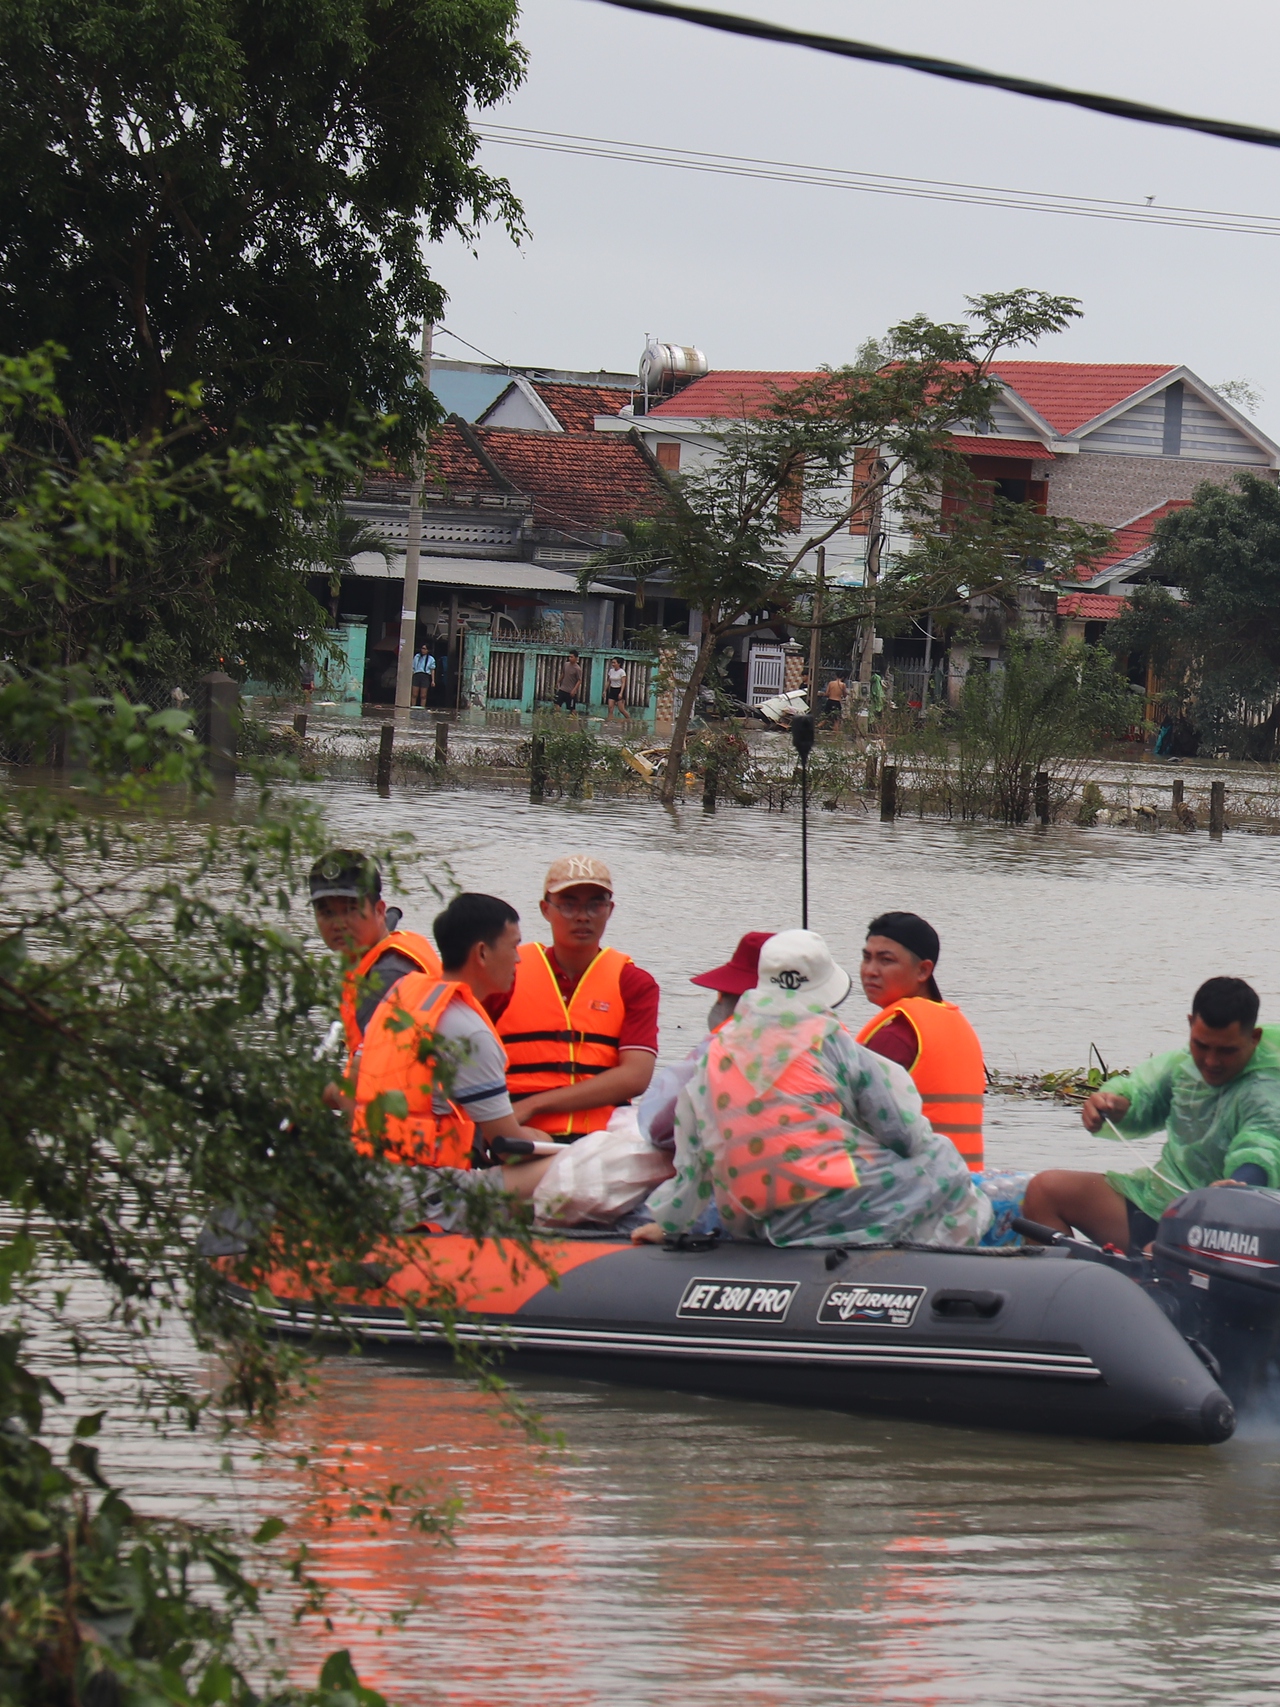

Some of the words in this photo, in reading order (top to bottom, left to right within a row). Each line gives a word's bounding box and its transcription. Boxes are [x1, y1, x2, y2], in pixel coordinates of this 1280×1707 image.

[1202, 1228, 1259, 1256] YAMAHA
[682, 1285, 721, 1309] JET
[714, 1286, 751, 1311] 380
[746, 1288, 791, 1313] PRO
